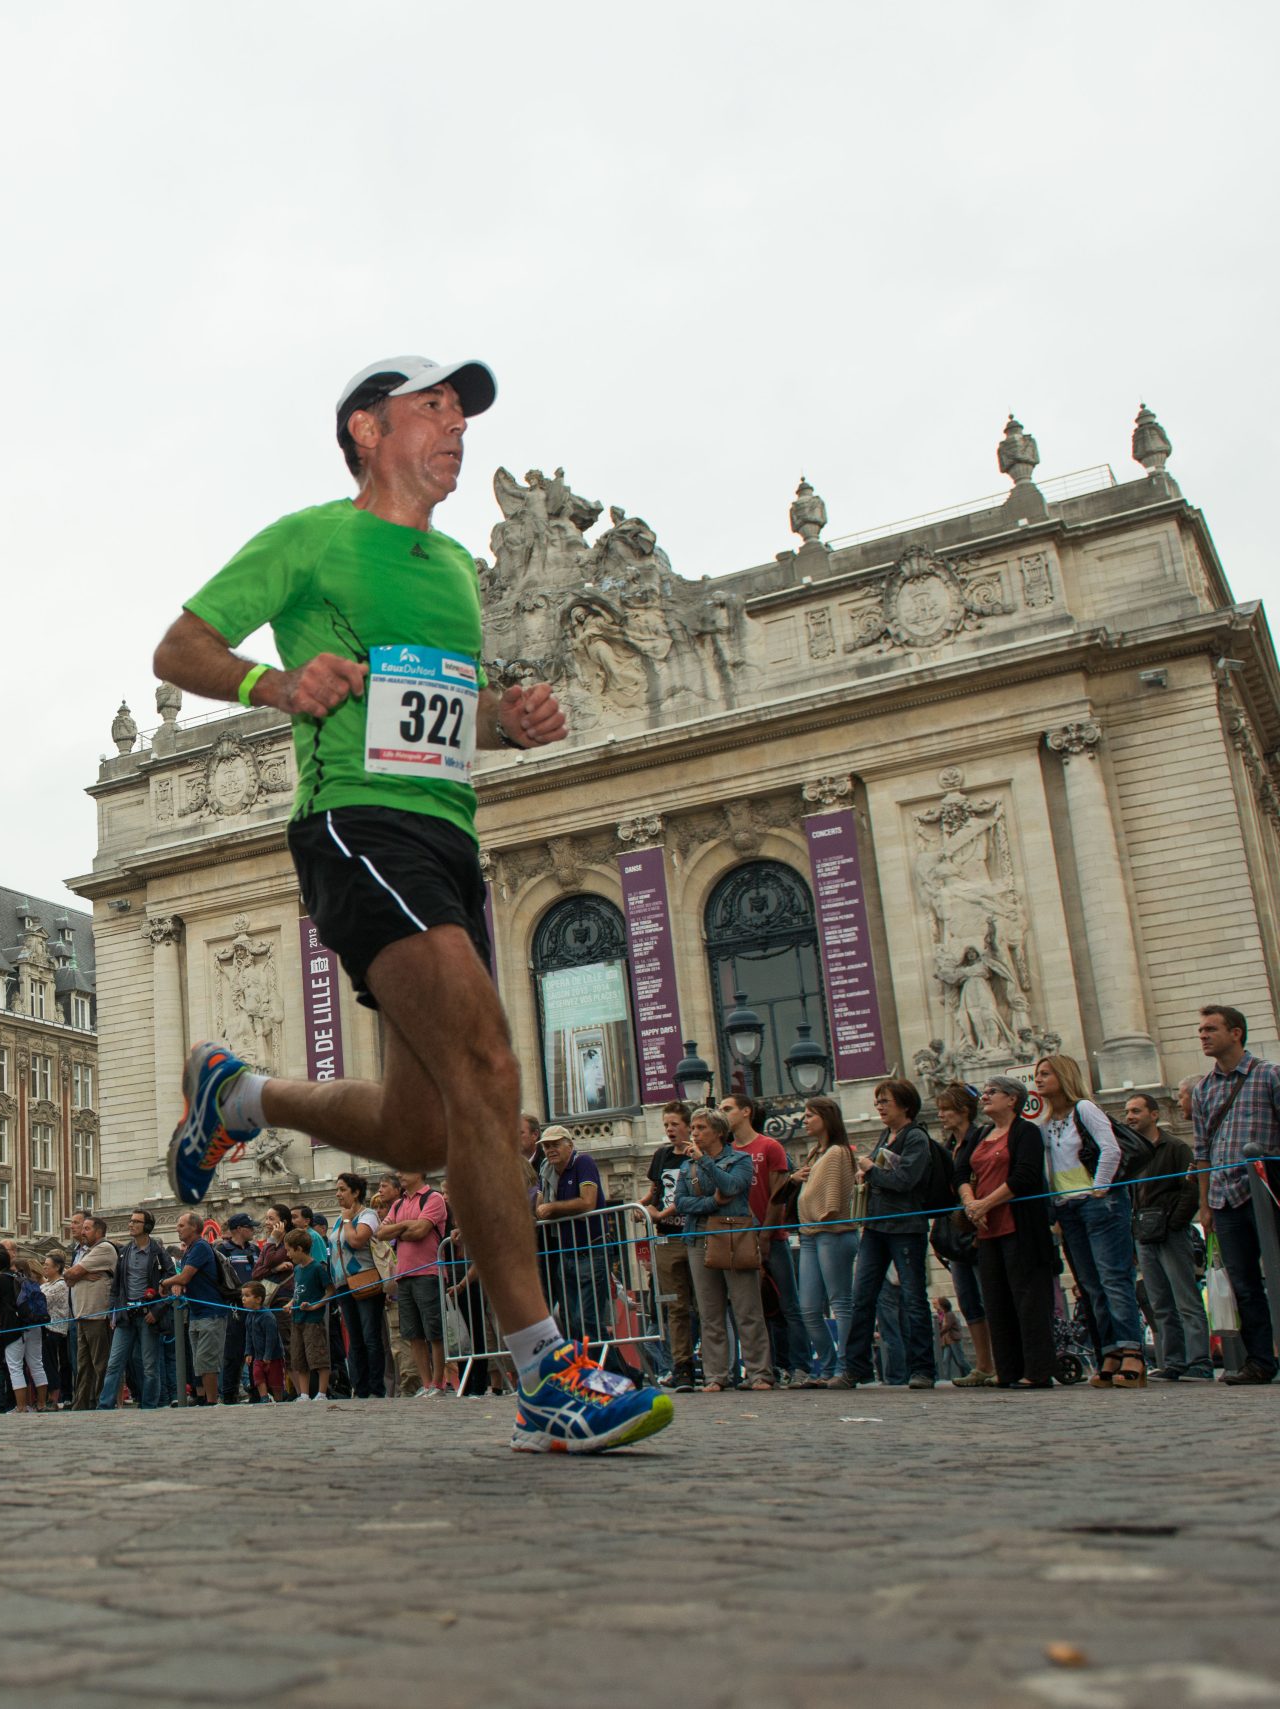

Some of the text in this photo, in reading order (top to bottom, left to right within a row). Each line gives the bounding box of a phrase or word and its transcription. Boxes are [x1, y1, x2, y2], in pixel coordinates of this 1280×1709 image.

[399, 690, 464, 749] 322
[812, 826, 842, 838] CONCERTS
[624, 864, 643, 874] DANSE
[308, 928, 318, 948] 2013
[312, 976, 332, 1025] LILLE
[641, 1028, 660, 1037] HAPPY
[660, 1026, 674, 1035] DAYS
[314, 1028, 334, 1053] DE
[1023, 1098, 1039, 1112] 30
